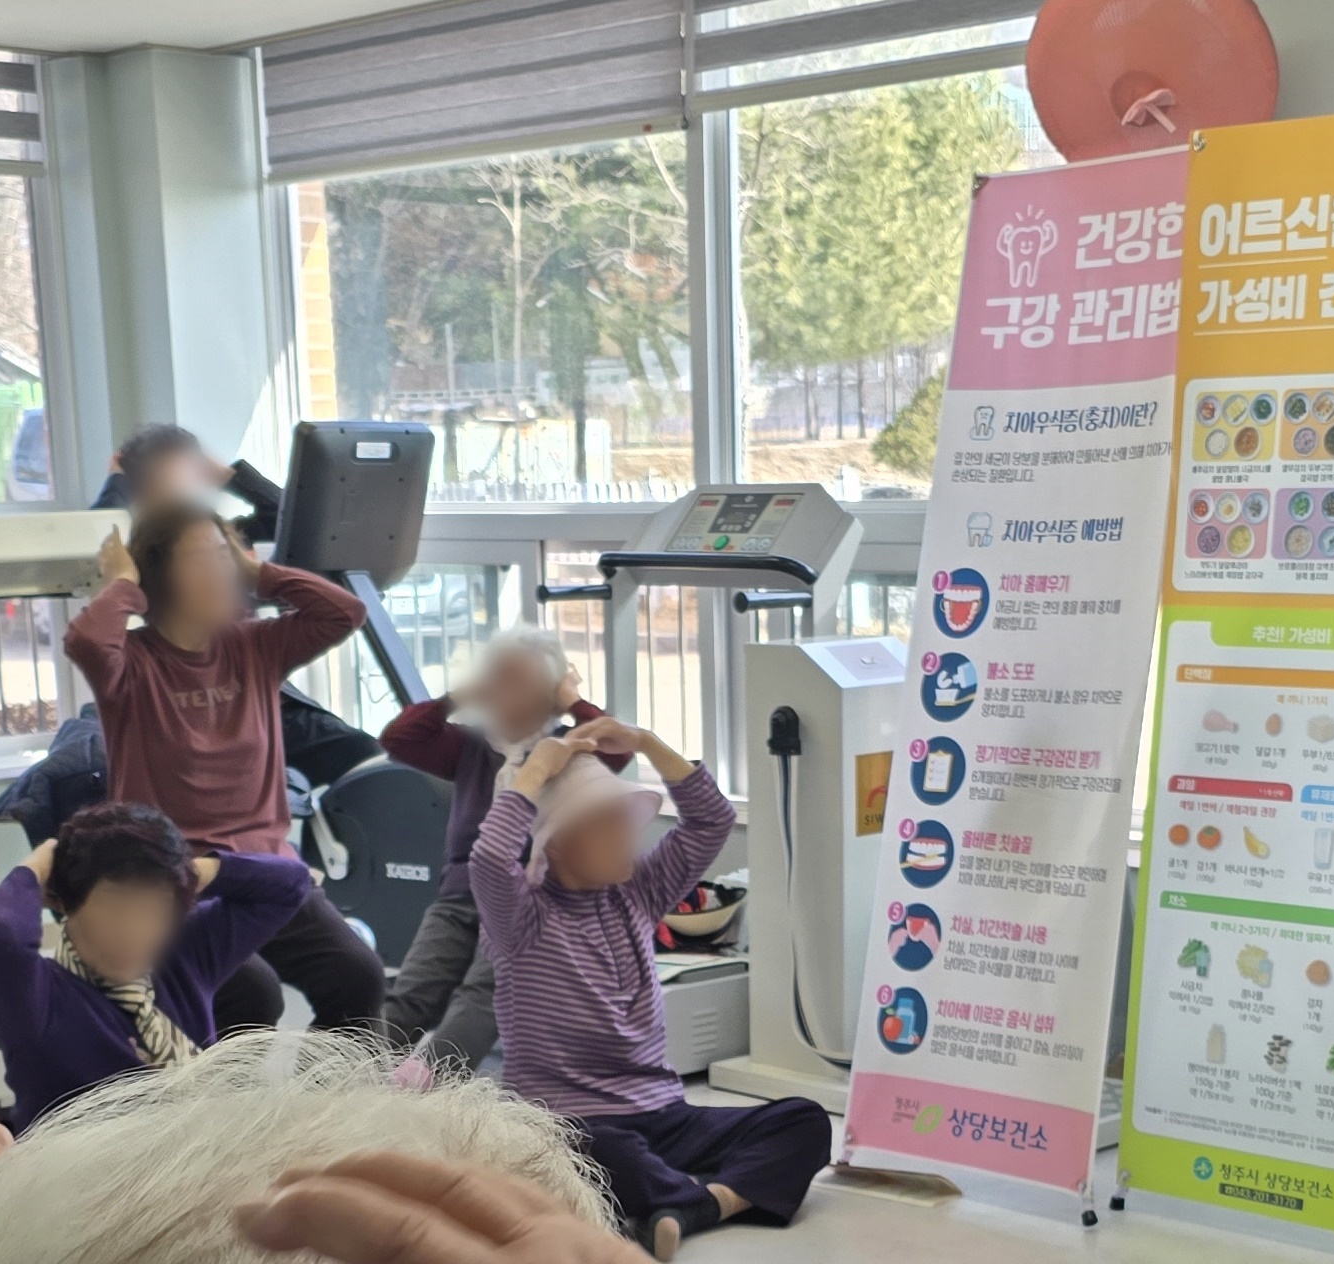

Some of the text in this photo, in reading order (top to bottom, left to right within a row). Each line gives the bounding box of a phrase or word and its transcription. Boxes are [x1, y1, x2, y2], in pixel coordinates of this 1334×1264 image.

[1075, 202, 1185, 269] 건강한
[981, 278, 1181, 350] 구강 관리법
[1197, 274, 1305, 325] 가성비
[1003, 402, 1158, 434] 치아우식증(충치)이란?
[1001, 517, 1123, 543] 치아우식증 예방법
[1252, 626, 1285, 643] 추천!
[1288, 627, 1331, 645] 가성비
[1012, 663, 1036, 681] 도포
[948, 1107, 1048, 1151] 상당보건소
[1219, 1163, 1334, 1200] 청주시 상당보건소
